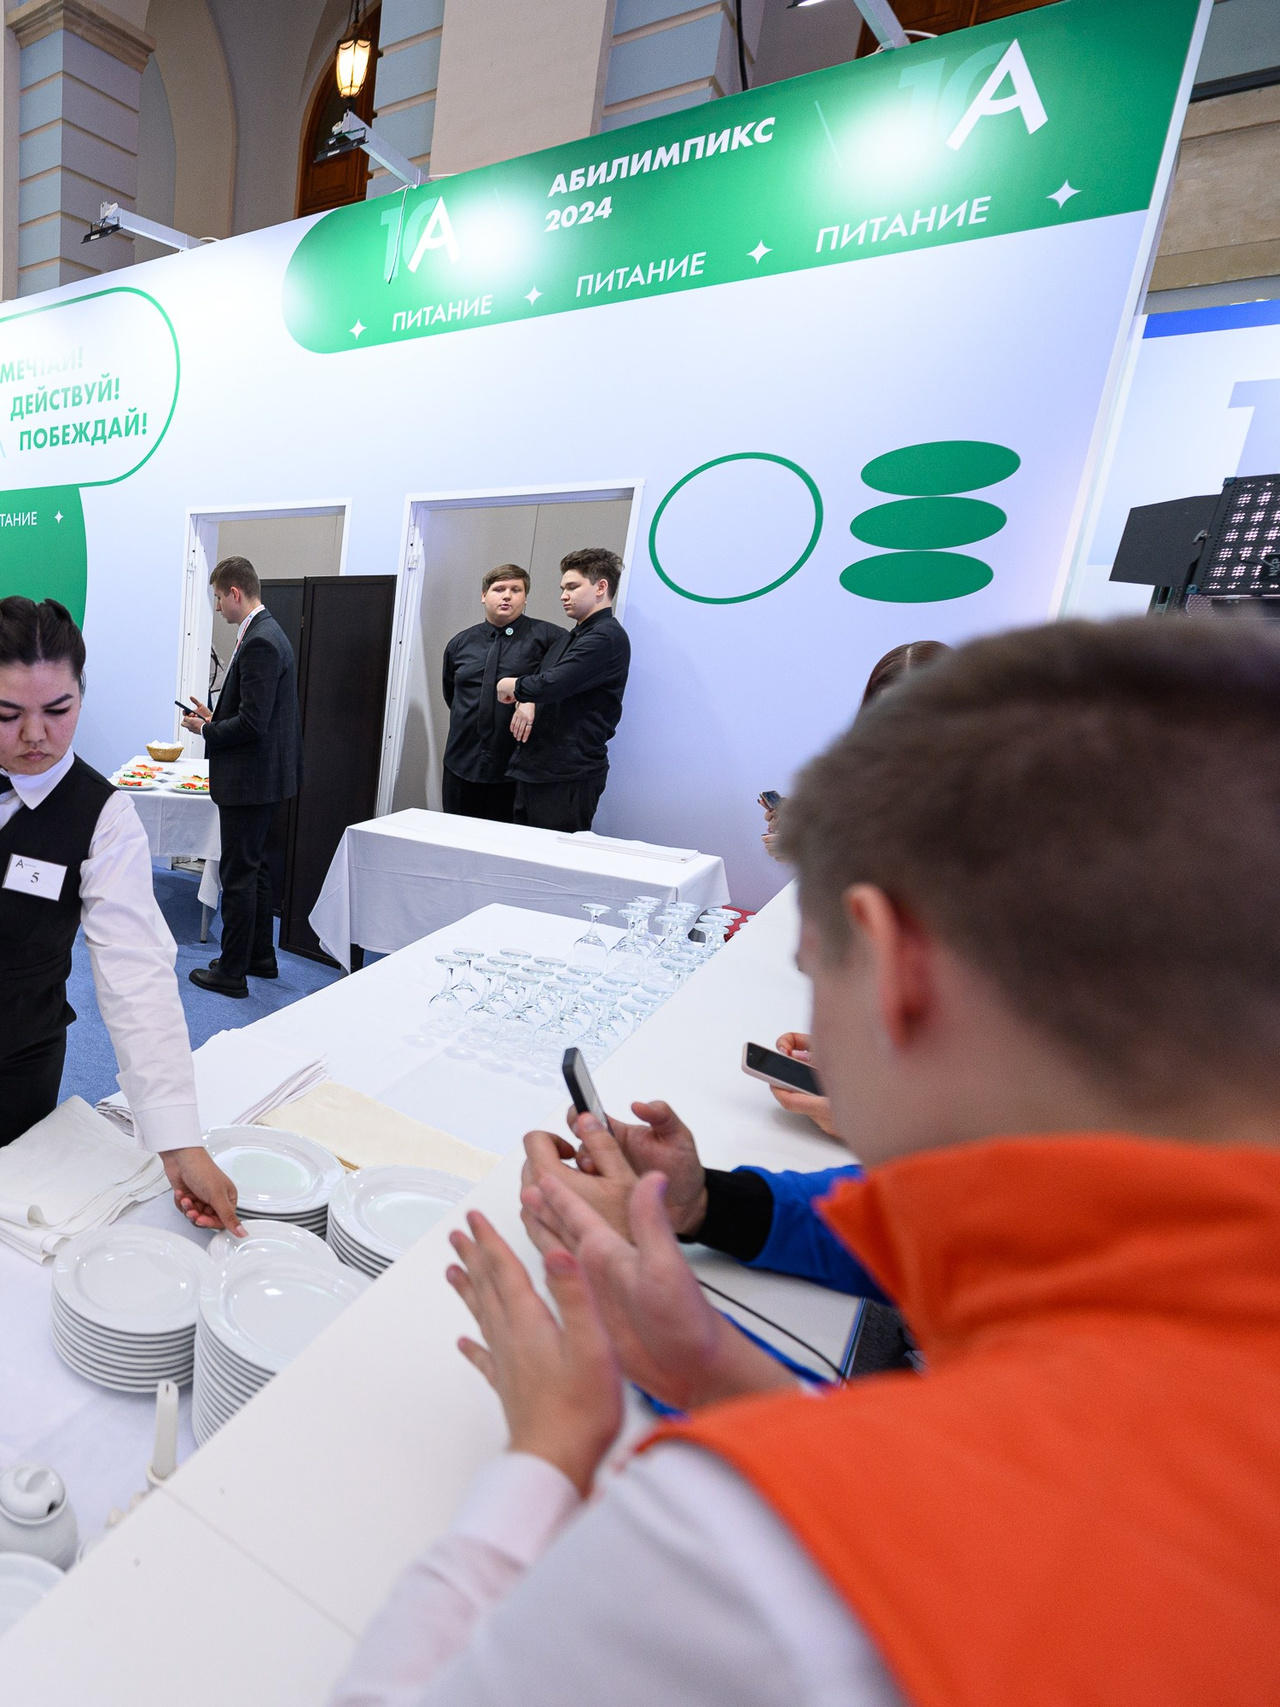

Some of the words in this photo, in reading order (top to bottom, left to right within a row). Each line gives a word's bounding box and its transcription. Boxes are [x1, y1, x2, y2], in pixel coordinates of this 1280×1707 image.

[547, 117, 775, 198] АБИЛИМПИКС
[543, 197, 613, 233] 2024
[392, 295, 493, 332] ПИТАНИЕ
[575, 252, 707, 298] ПИТАНИЕ
[815, 196, 991, 253] ПИТАНИЕ
[10, 372, 120, 421] ДЕЙСТВУЙ!
[20, 407, 148, 451] ПОБЕЖДАЙ!
[30, 872, 40, 883] 5
